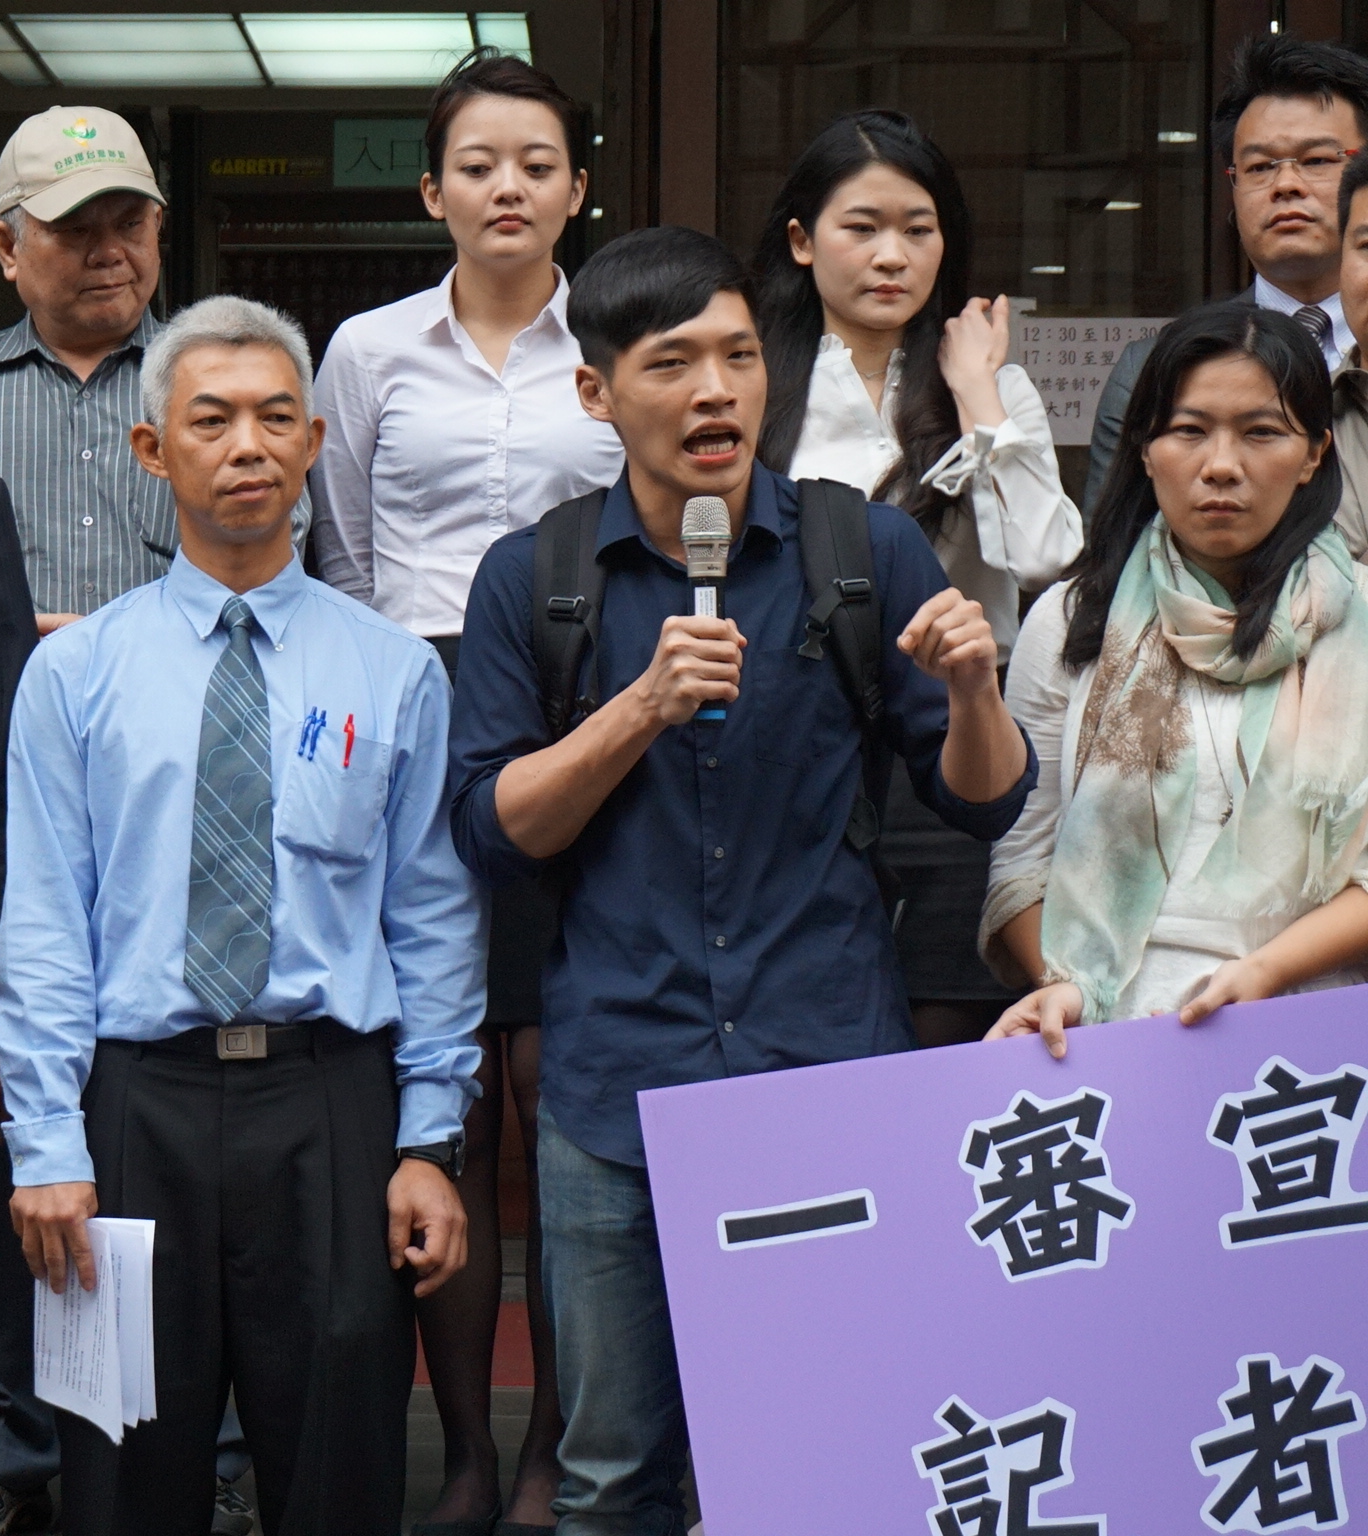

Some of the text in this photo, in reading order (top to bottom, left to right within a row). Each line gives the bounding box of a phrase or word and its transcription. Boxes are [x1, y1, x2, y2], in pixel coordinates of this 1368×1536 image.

[210, 158, 287, 175] GARRETT
[345, 137, 423, 173] 入口
[1046, 400, 1081, 418] 大門
[724, 1063, 1368, 1277] 一審宣
[920, 1360, 1358, 1536] 記者
